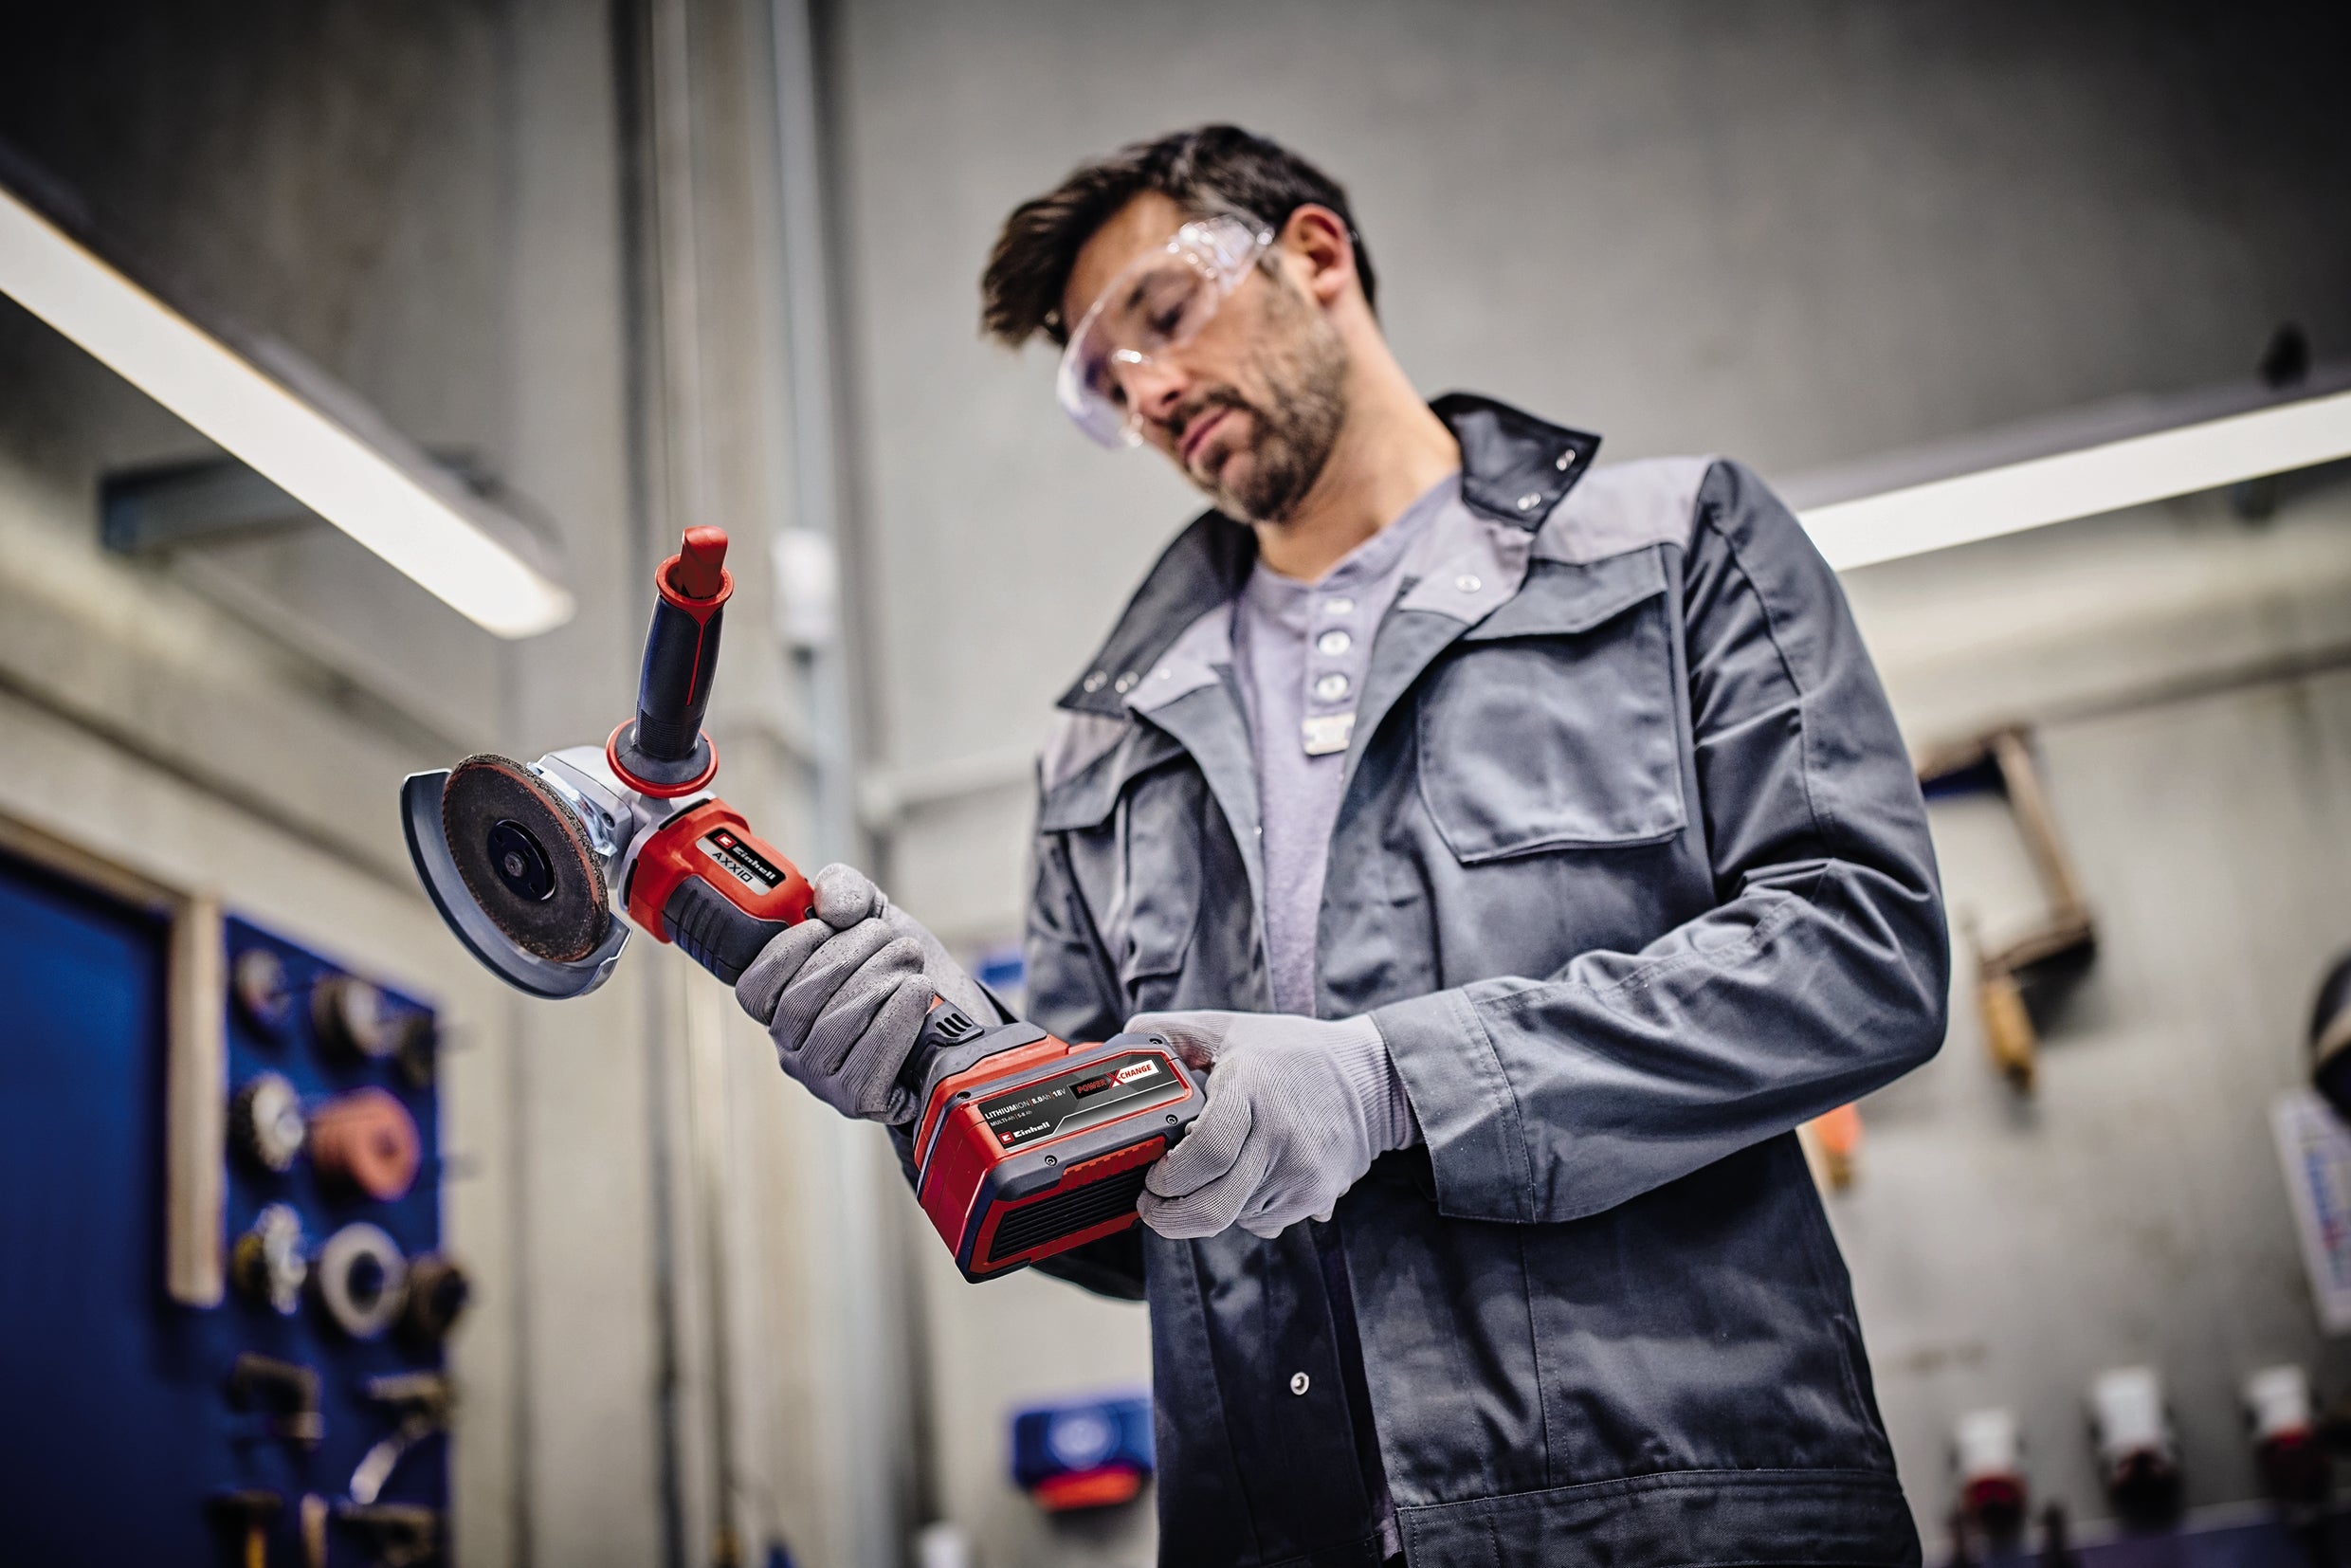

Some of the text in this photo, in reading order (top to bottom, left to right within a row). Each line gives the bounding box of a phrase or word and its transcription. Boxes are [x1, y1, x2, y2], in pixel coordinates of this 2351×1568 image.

[712, 852, 753, 883] AXXIO
[733, 846, 776, 880] Einhell
[1077, 1064, 1153, 1094] POWER X-CHANGE
[1012, 1121, 1050, 1139] Einhell
